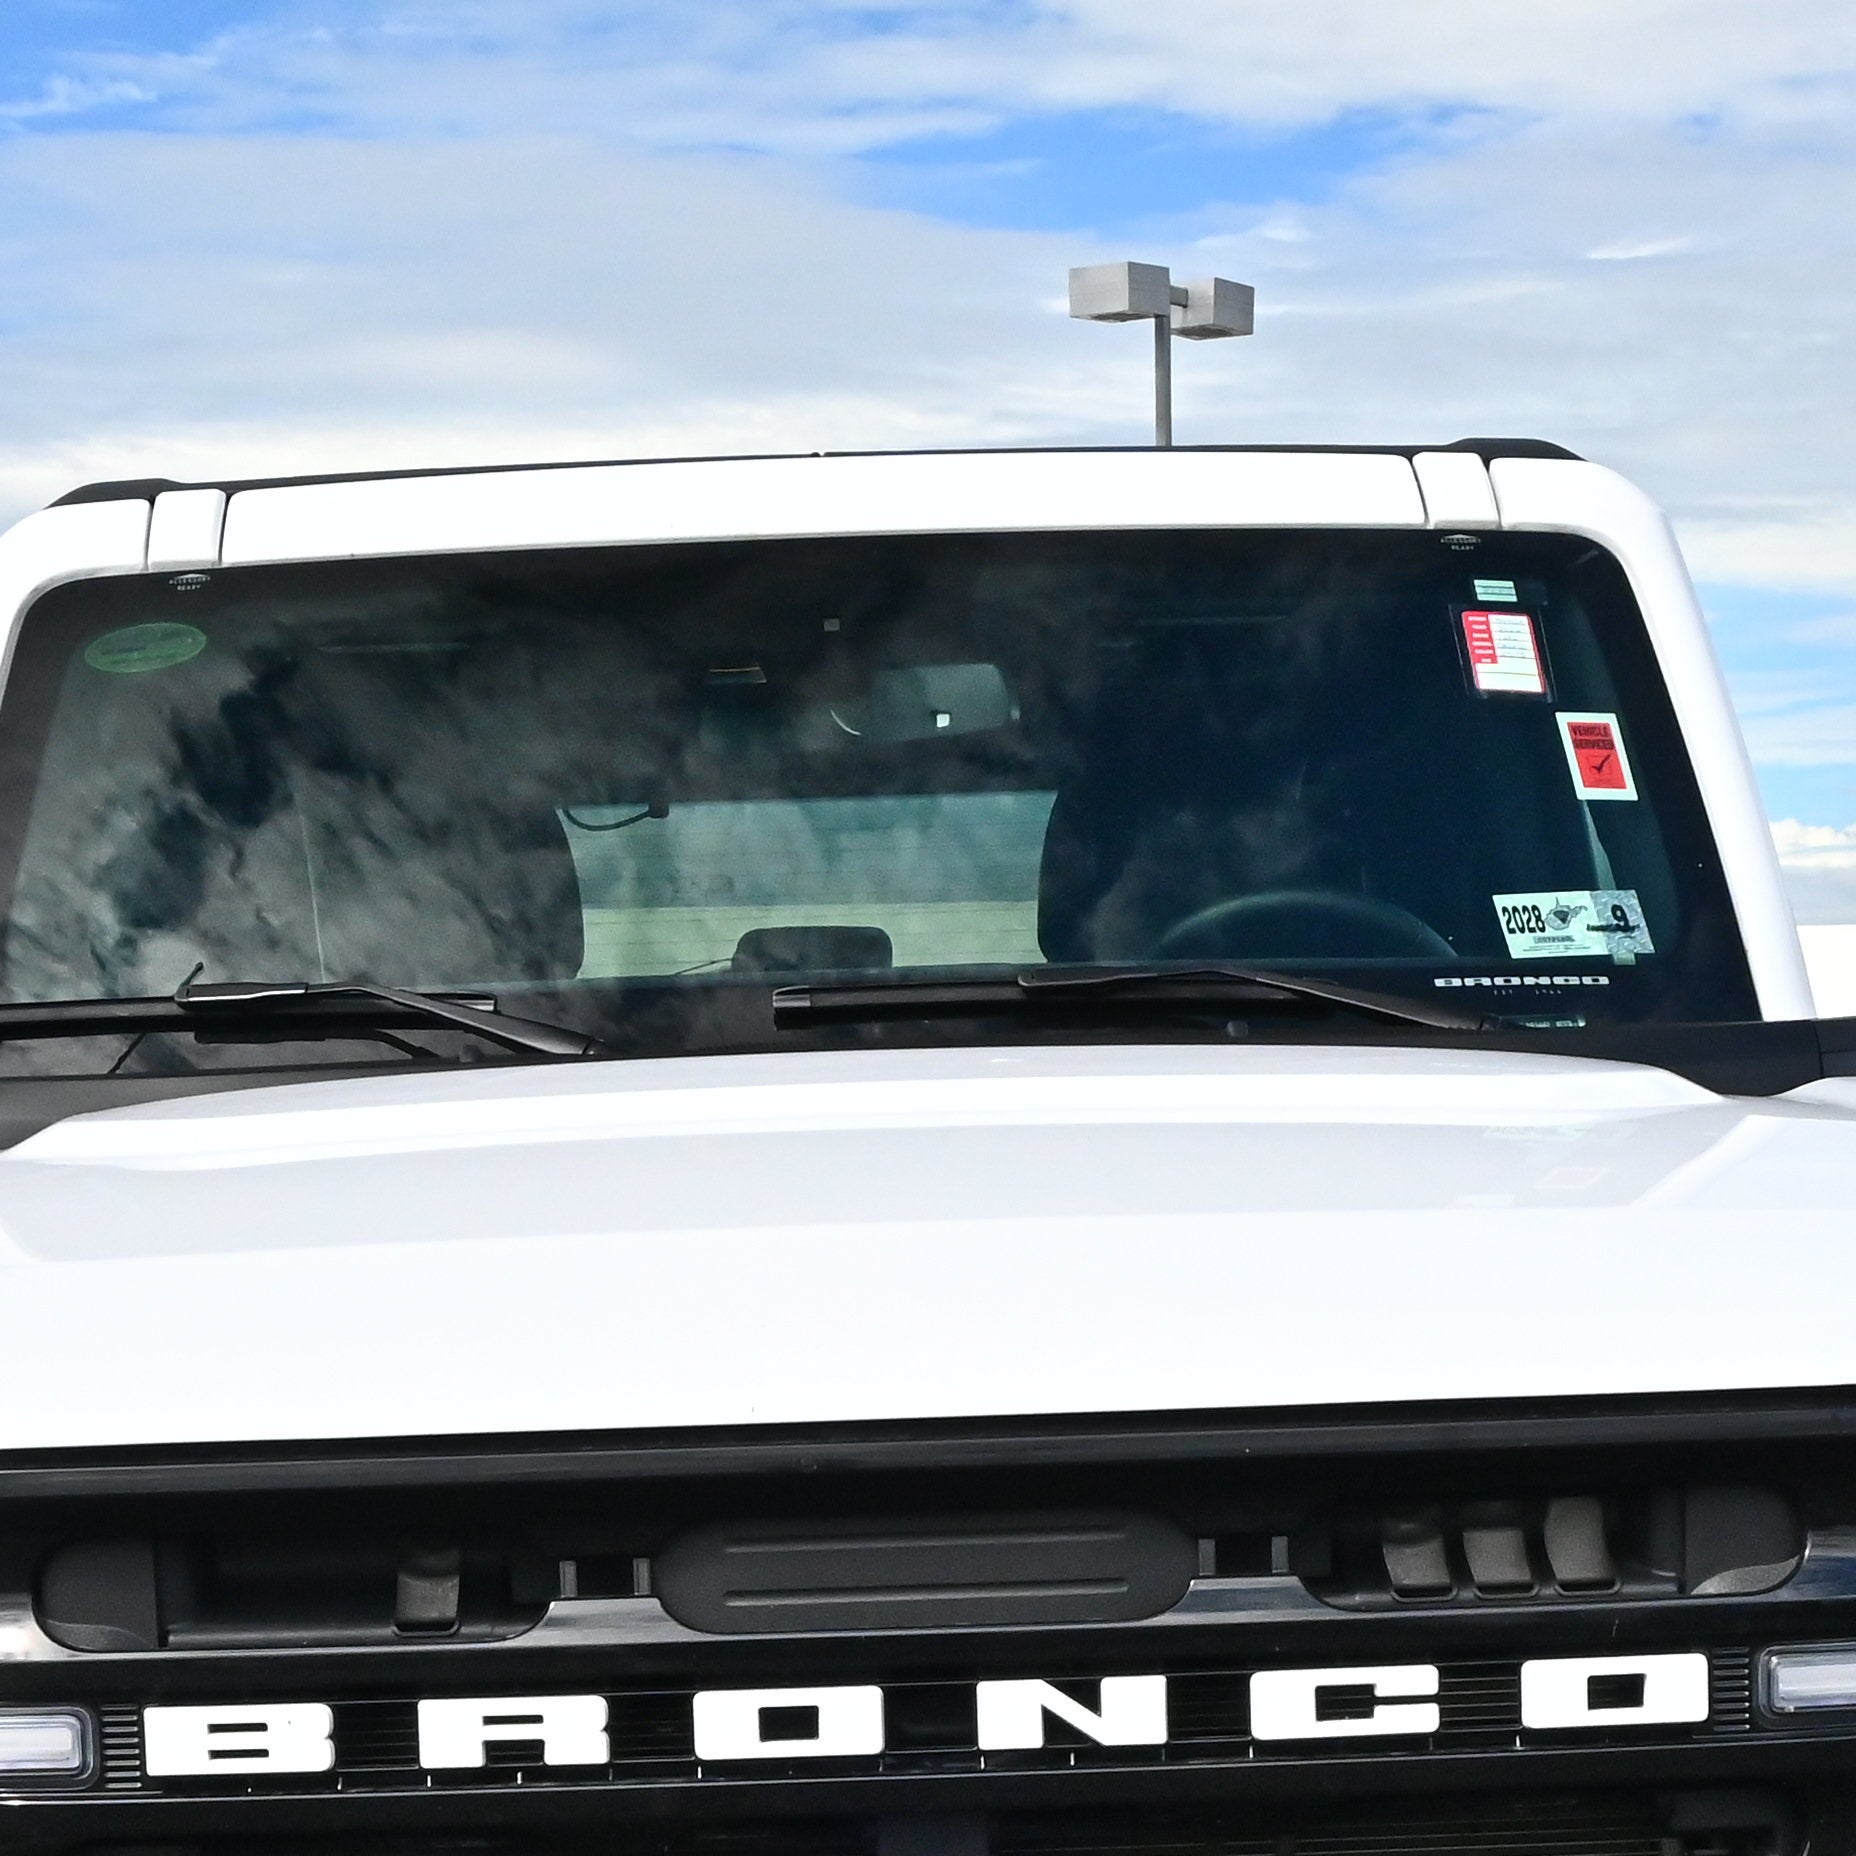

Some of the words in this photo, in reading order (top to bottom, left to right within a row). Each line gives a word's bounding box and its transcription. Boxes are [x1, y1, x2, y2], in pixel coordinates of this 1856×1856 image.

[1571, 725, 1610, 737] VEHICLE
[1502, 904, 1546, 935] 2028
[1610, 904, 1630, 932] 9
[1434, 976, 1610, 987] BRONCO
[142, 1652, 1710, 1778] BRONCO
